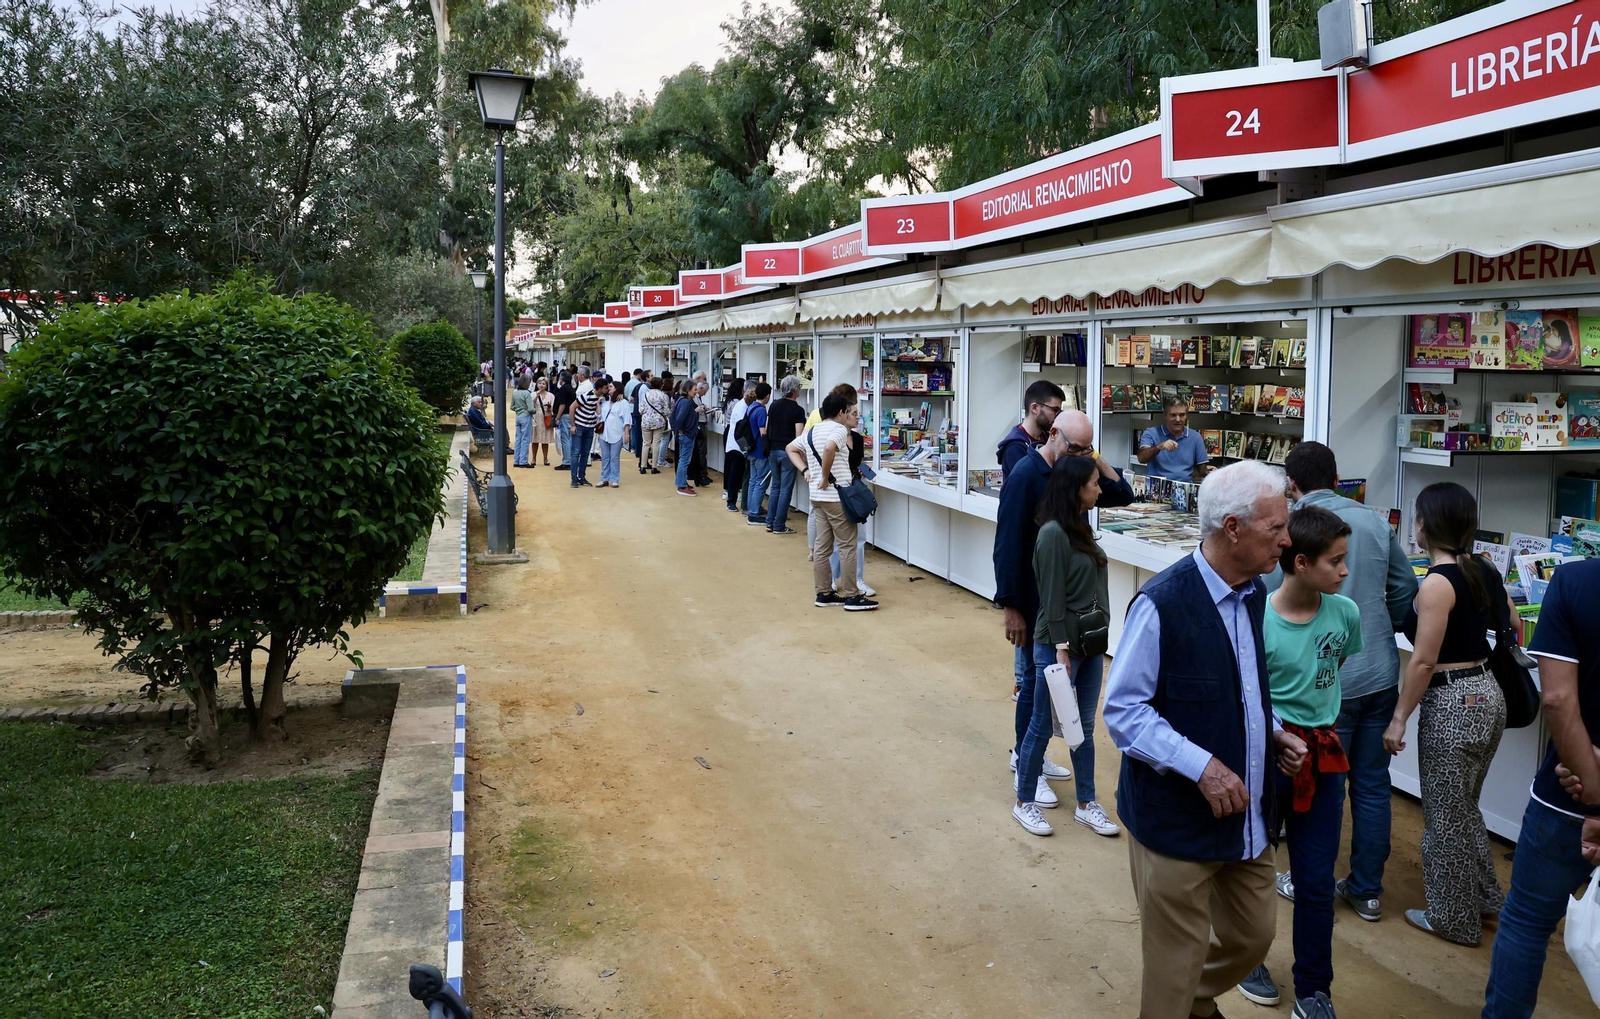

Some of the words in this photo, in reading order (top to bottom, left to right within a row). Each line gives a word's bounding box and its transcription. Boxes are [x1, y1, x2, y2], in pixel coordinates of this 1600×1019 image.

[1451, 14, 1600, 98] LIBRERÍA
[1225, 108, 1261, 137] 24
[982, 189, 1033, 221] EDITORIAL
[1035, 158, 1132, 207] RENACIMIENTO
[896, 218, 915, 234] 23
[832, 246, 838, 260] EL
[764, 258, 776, 269] 22
[699, 281, 706, 290] 21
[653, 295, 662, 303] 20
[1032, 295, 1088, 316] EDITORIAL
[1096, 283, 1205, 310] RENACIMIENTO
[1496, 412, 1533, 426] CUENTO
[1537, 414, 1563, 423] uerpo
